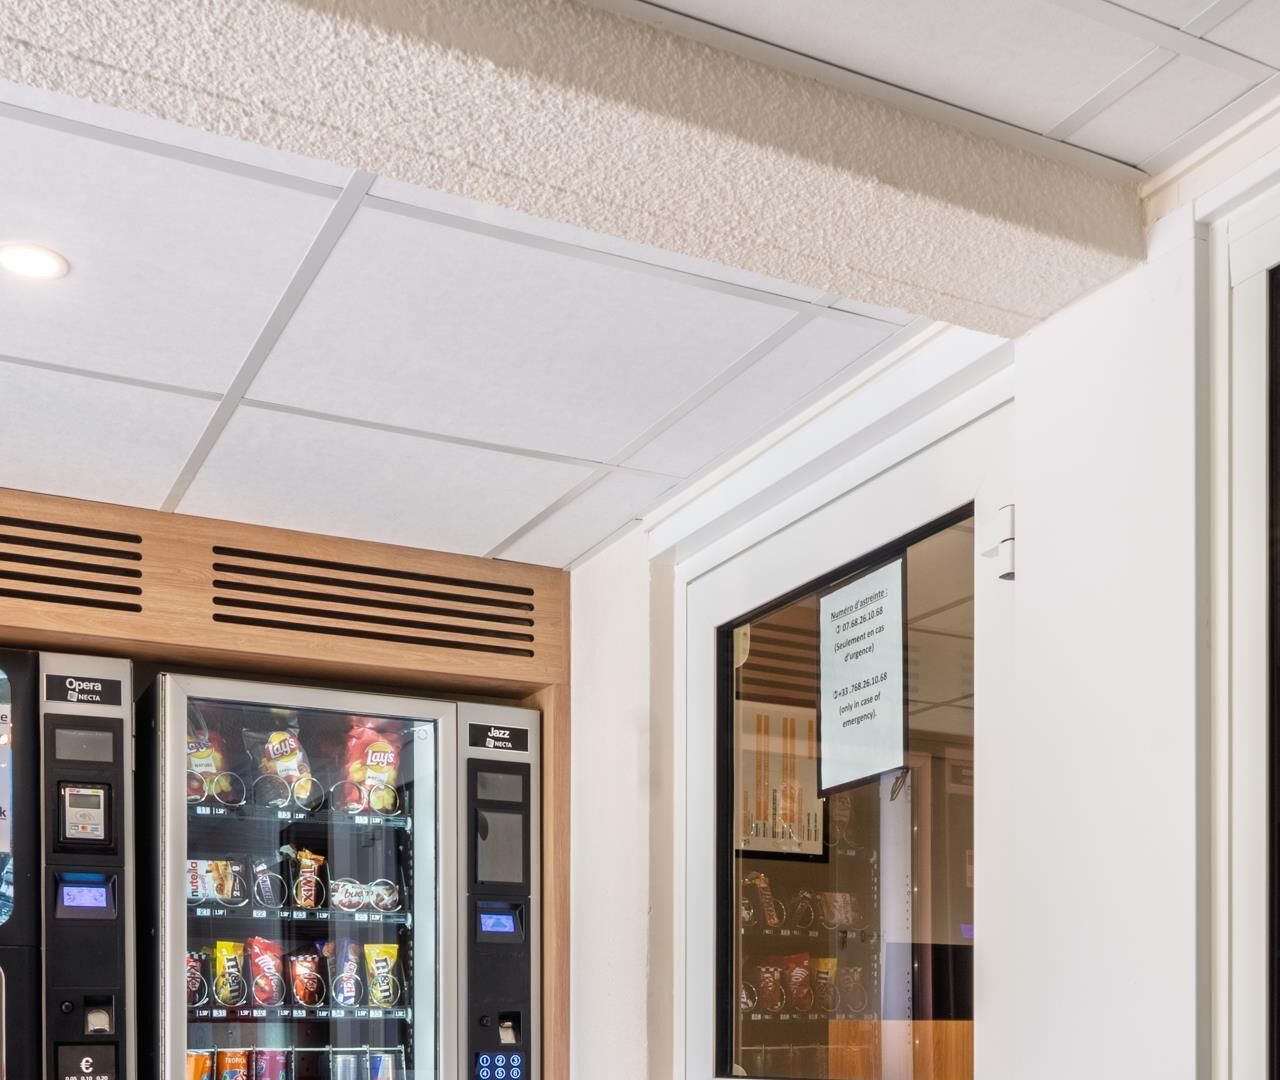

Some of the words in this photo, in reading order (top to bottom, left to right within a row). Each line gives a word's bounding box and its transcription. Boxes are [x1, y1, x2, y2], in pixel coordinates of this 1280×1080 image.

[834, 632, 866, 653] (Seulement
[867, 629, 875, 638] en
[875, 624, 885, 634] cas
[844, 642, 875, 662] d'urgence)
[65, 678, 102, 692] Opera
[78, 694, 101, 702] NECTA
[840, 702, 853, 716] (only
[854, 700, 860, 709] in
[861, 696, 873, 706] case
[874, 691, 881, 701] of
[487, 727, 510, 739] Jazz
[367, 749, 395, 767] Lay's
[187, 861, 199, 897] nutella
[301, 865, 318, 902] TWIX
[80, 1057, 93, 1073] €
